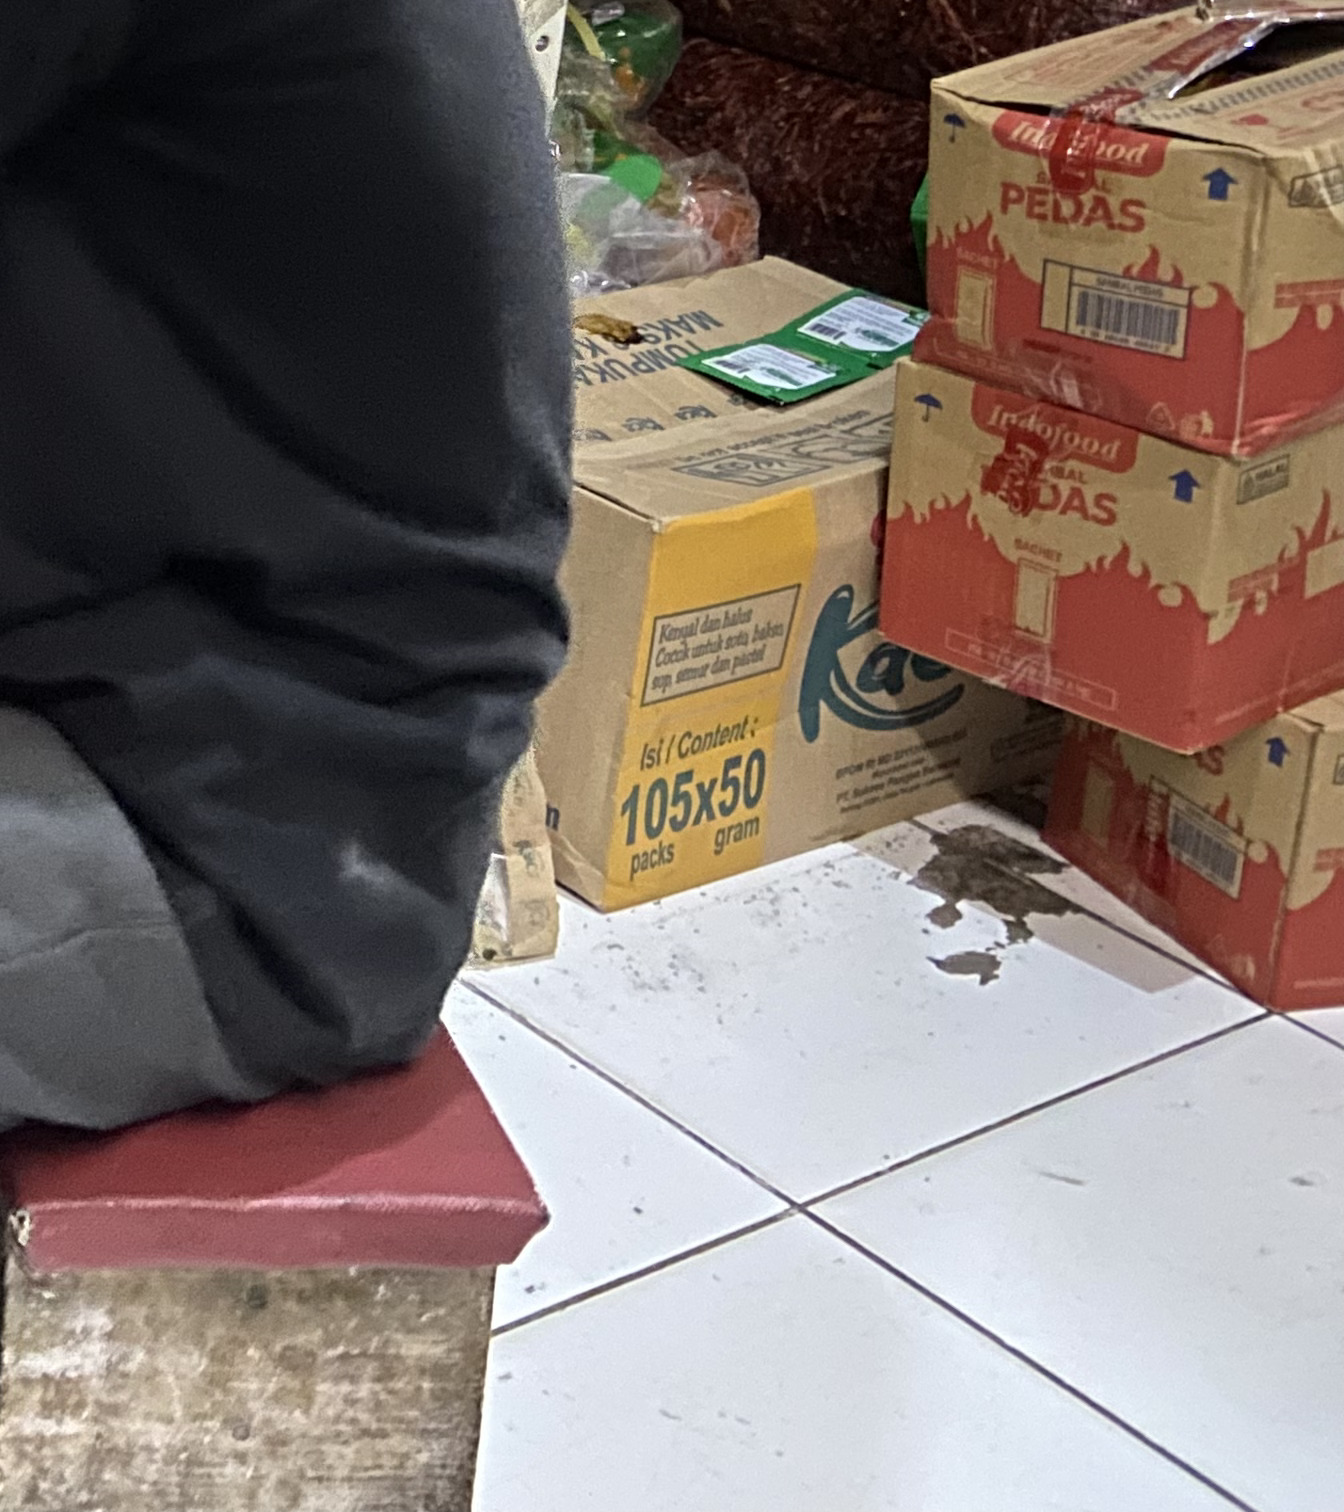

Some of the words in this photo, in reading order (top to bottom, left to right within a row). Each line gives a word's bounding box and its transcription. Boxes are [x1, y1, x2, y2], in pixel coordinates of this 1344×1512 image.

[999, 180, 1146, 234] PEDAS
[987, 403, 1122, 462] Indofood
[639, 740, 664, 771] Isi
[677, 721, 749, 759] Content
[621, 747, 767, 847] 105x50
[629, 845, 675, 881] packs
[713, 814, 761, 856] gram
